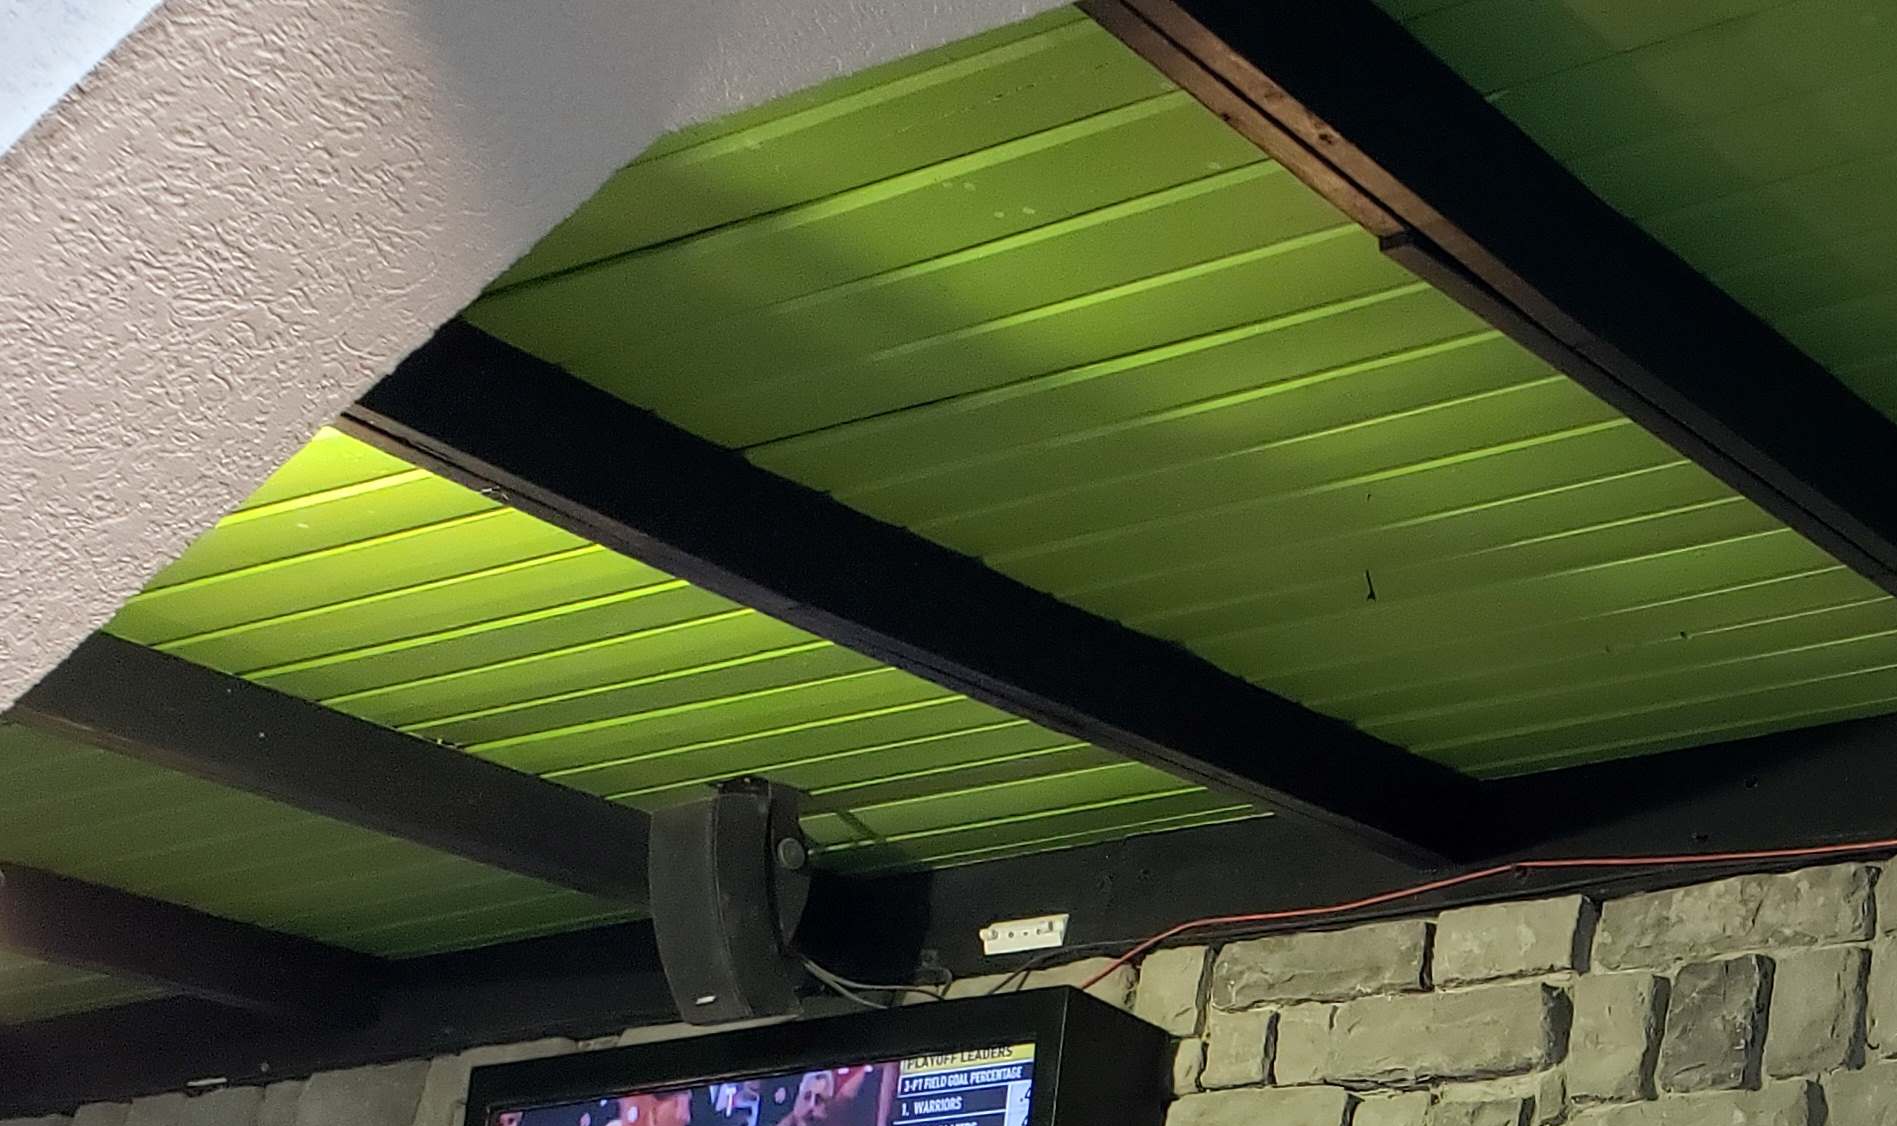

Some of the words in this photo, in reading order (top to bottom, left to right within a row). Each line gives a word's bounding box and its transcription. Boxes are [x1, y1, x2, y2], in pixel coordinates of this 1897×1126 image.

[924, 1075, 947, 1090] FIELD
[970, 1066, 1023, 1084] PERCENTAGE
[913, 1096, 963, 1115] WARRIORS
